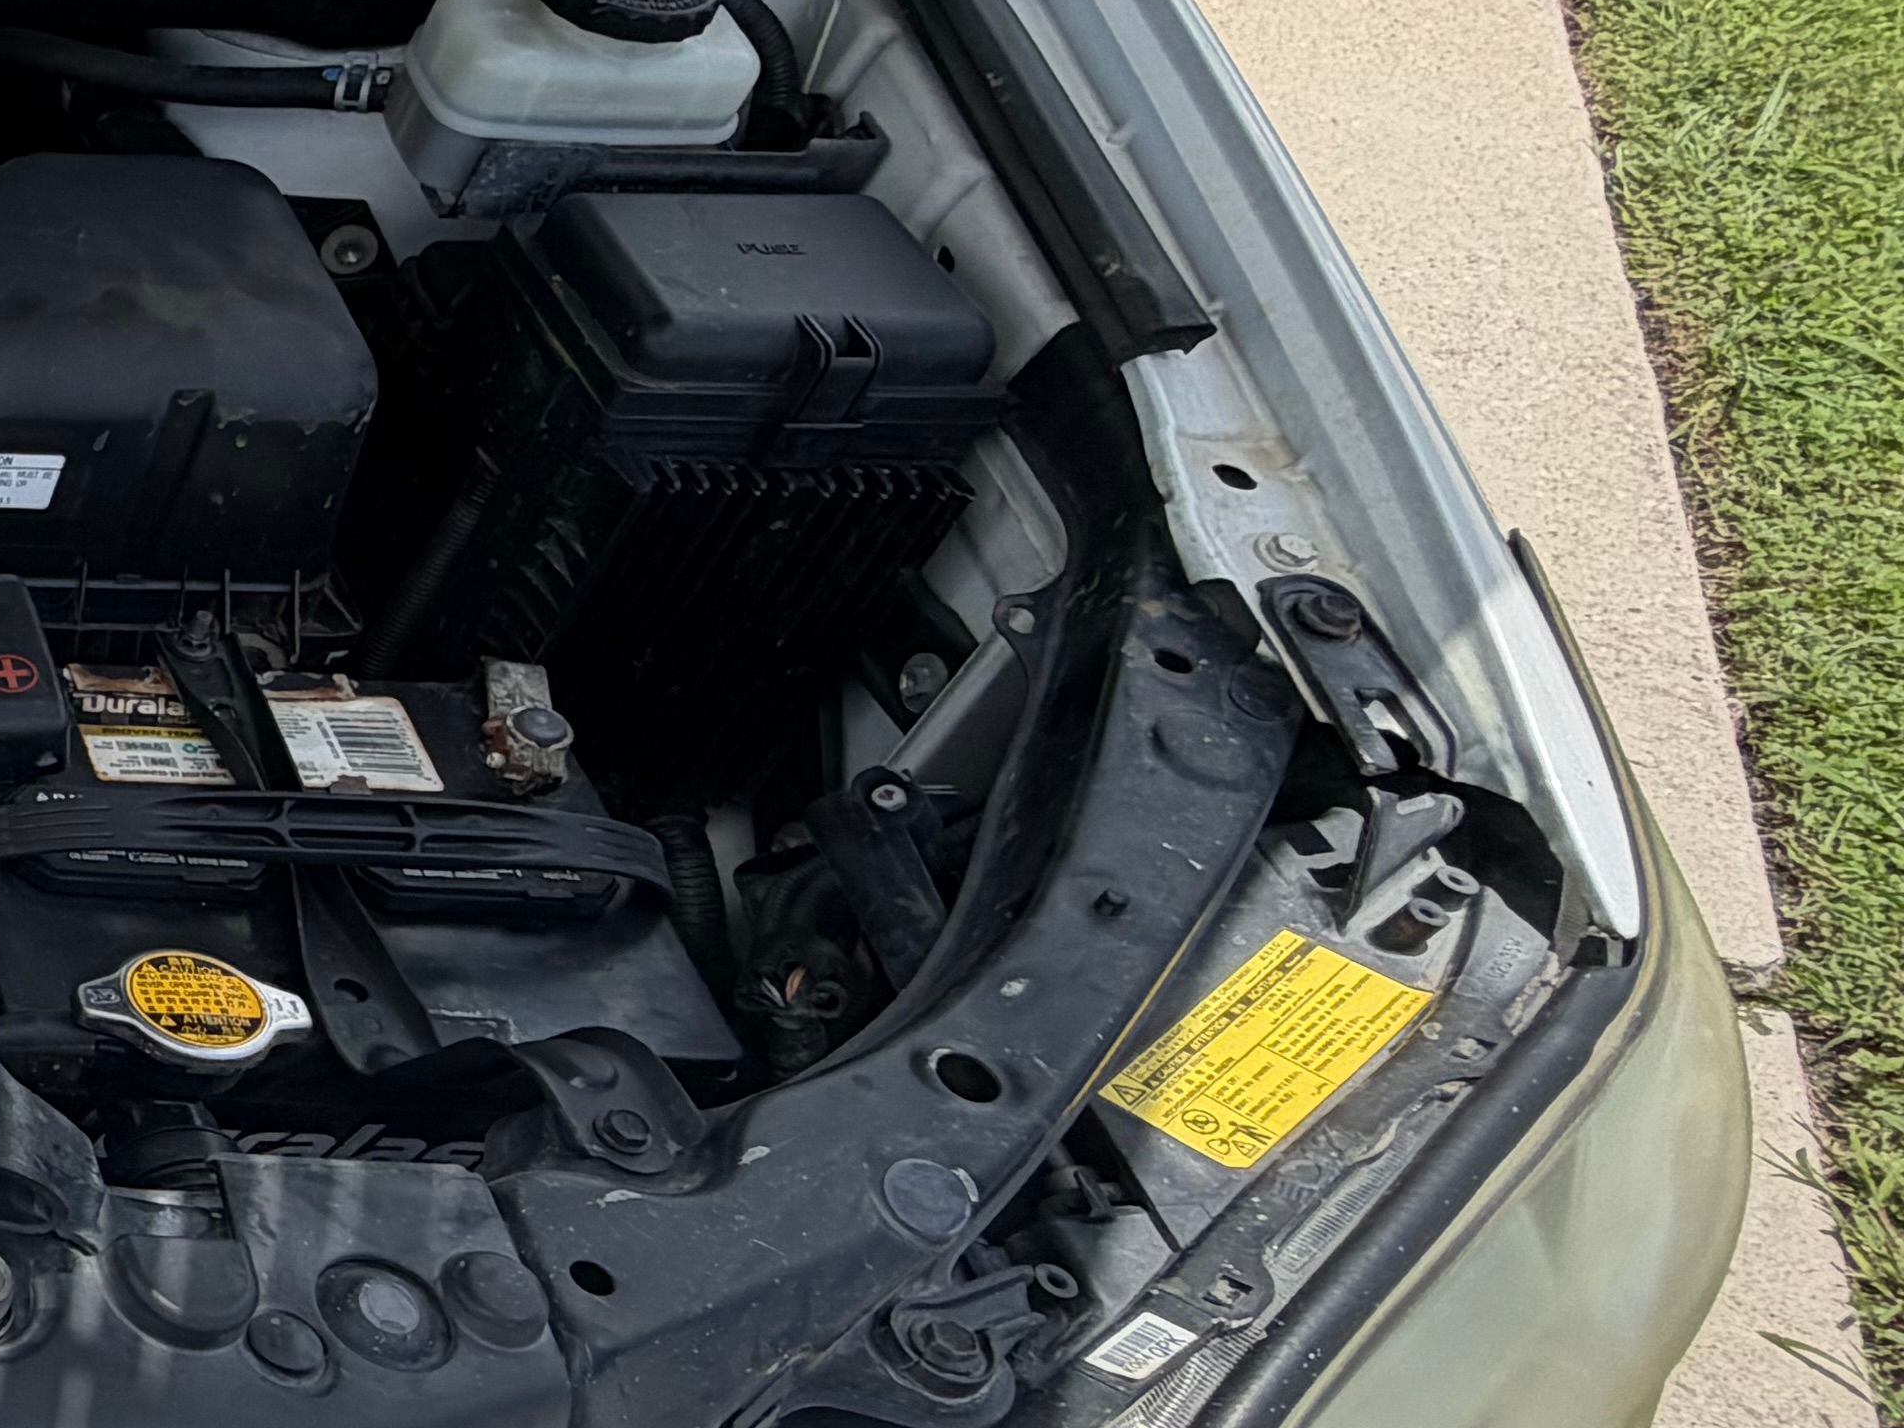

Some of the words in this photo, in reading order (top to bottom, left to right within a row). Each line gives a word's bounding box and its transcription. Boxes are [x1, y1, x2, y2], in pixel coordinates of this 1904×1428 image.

[736, 243, 808, 256] FUSE
[158, 964, 223, 976] CAUTION
[183, 1014, 252, 1027] ATTENTION
